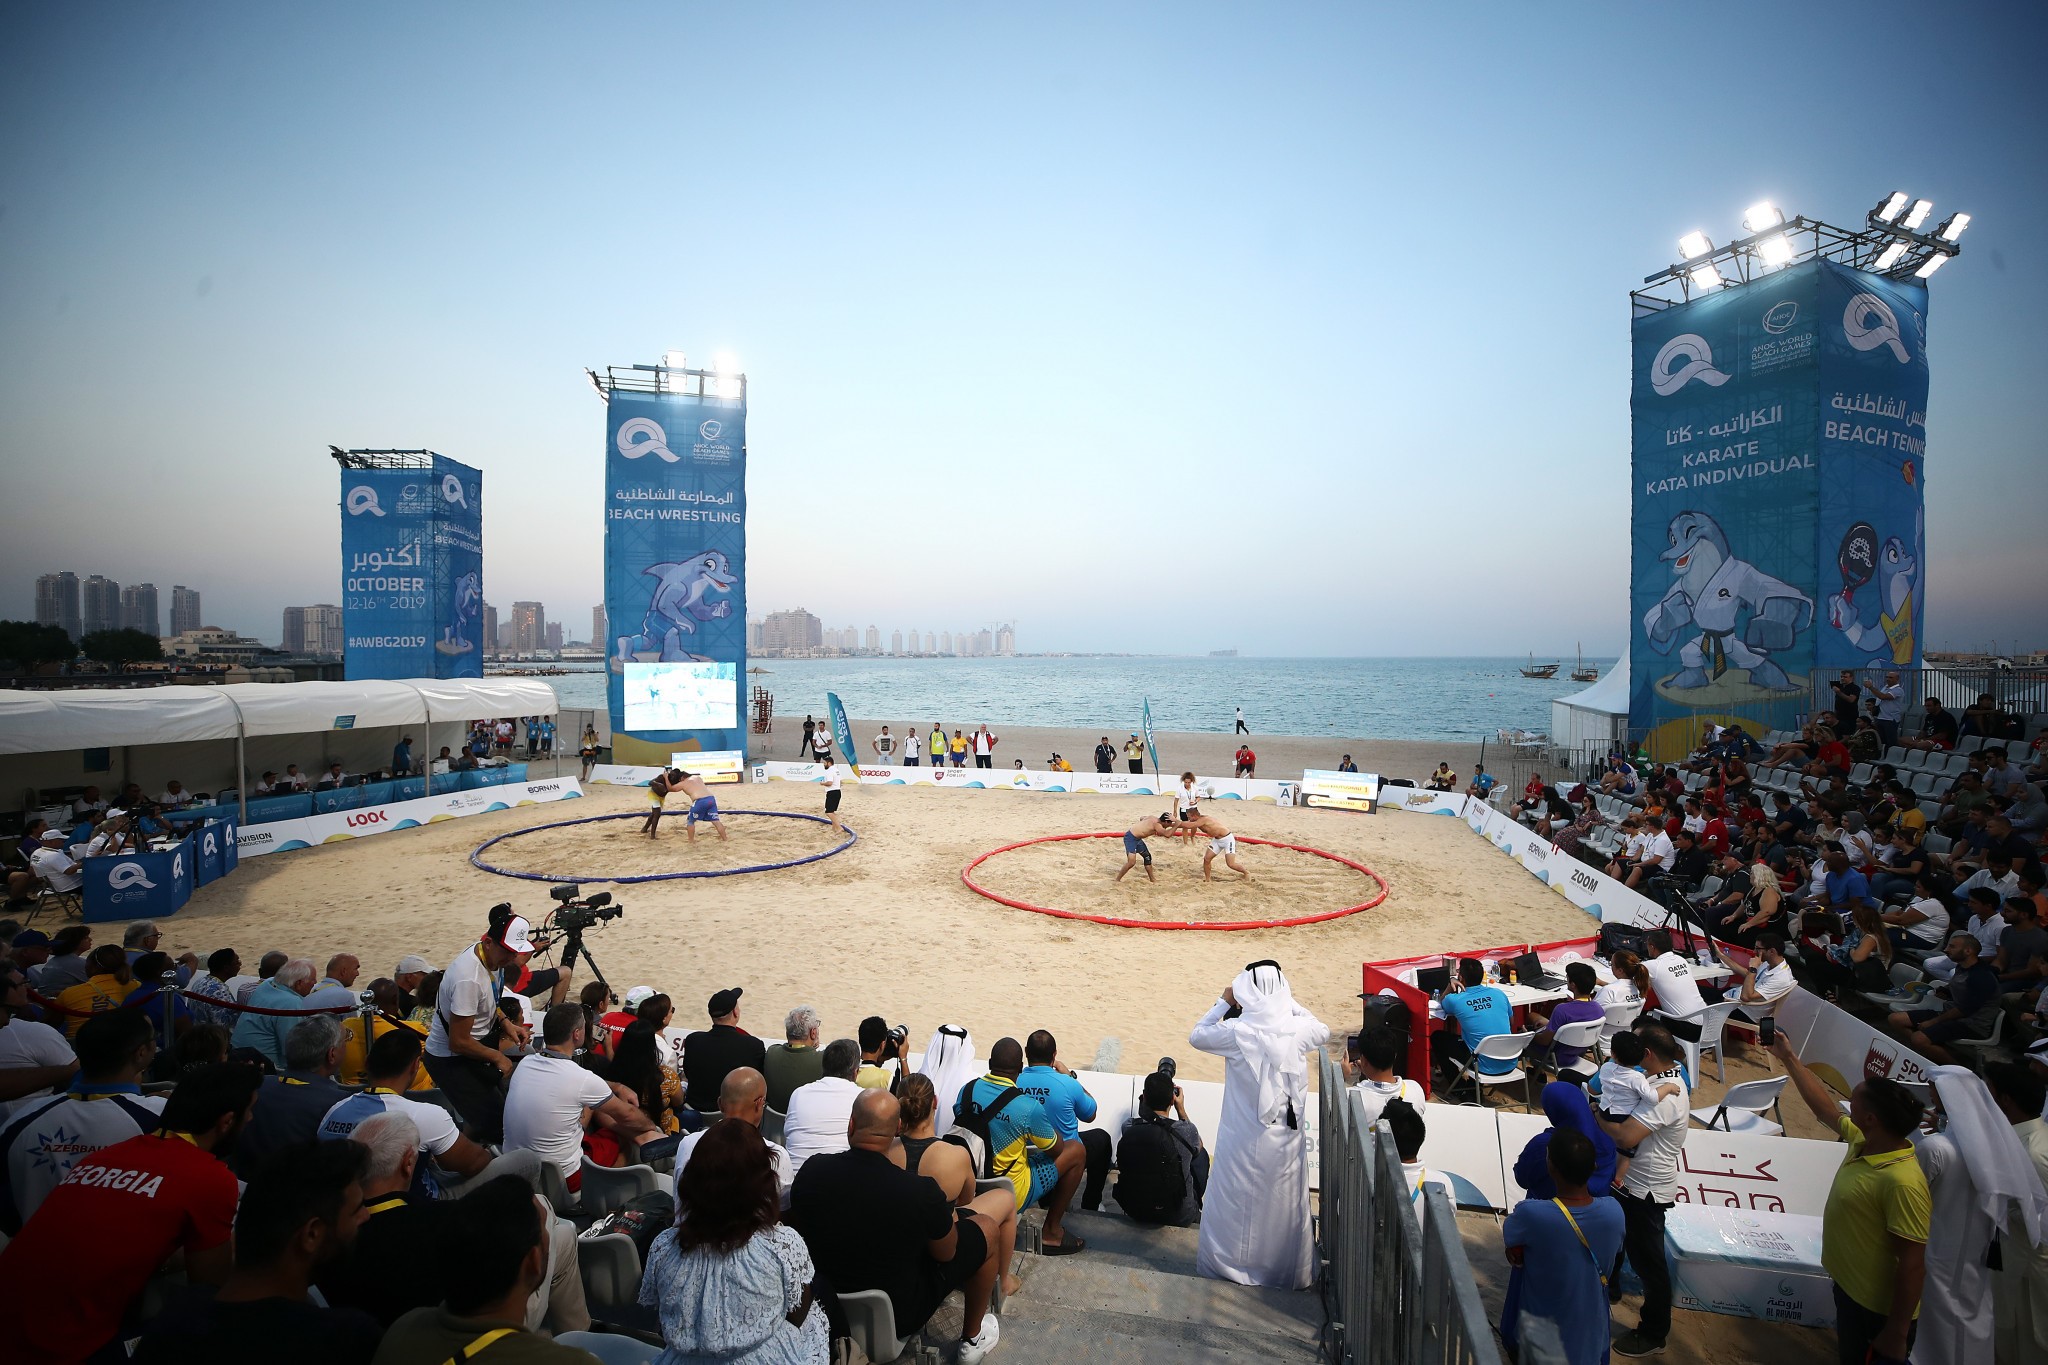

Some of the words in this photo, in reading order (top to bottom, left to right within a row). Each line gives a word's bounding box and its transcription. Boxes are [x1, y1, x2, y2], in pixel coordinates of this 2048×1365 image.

[1751, 341, 1776, 354] ANOC
[1778, 333, 1812, 347] WORLD
[1751, 347, 1779, 360] BEACH
[1781, 340, 1811, 353] GAMES
[1831, 391, 1907, 419] الشاطئية
[1709, 404, 1782, 438] الكاراتيه
[1666, 424, 1692, 446] كاتا
[1825, 420, 1888, 447] BEACH
[1892, 431, 1925, 458] TENNIS
[1682, 440, 1760, 468] KARATE
[1646, 476, 1688, 495] KATA
[1693, 453, 1815, 487] INDIVIDUAL
[616, 488, 675, 502] الشاطئية
[679, 490, 733, 505] المصارعة
[609, 508, 654, 520] BEACH
[657, 509, 741, 523] WRESTLING
[434, 535, 459, 546] BEACH
[351, 537, 422, 573] أكتوبر
[348, 577, 424, 592] OCTOBER
[390, 596, 426, 610] 2019
[349, 636, 426, 648] #AWBG2019
[755, 768, 764, 778] B
[528, 783, 560, 793] BORNAN
[1280, 787, 1291, 799] A
[1571, 868, 1598, 892] ZOOM
[1668, 963, 1688, 973] QATAR
[1674, 969, 1688, 978] 2019
[1466, 996, 1493, 1006] QATAR
[1473, 1002, 1492, 1012] 2019
[610, 1025, 626, 1033] AUSTR
[1866, 1062, 1885, 1077] QATAR
[1871, 1057, 1886, 1068] قطر
[1019, 1087, 1050, 1096] QATAR
[995, 1111, 1010, 1123] CIA
[324, 1120, 357, 1134] AZERB
[59, 1165, 164, 1198] GEORGIA
[1675, 1183, 1786, 1213] atara
[1766, 1296, 1803, 1310] الروضة
[1766, 1307, 1774, 1317] AL
[1776, 1308, 1802, 1320] RAWDA
